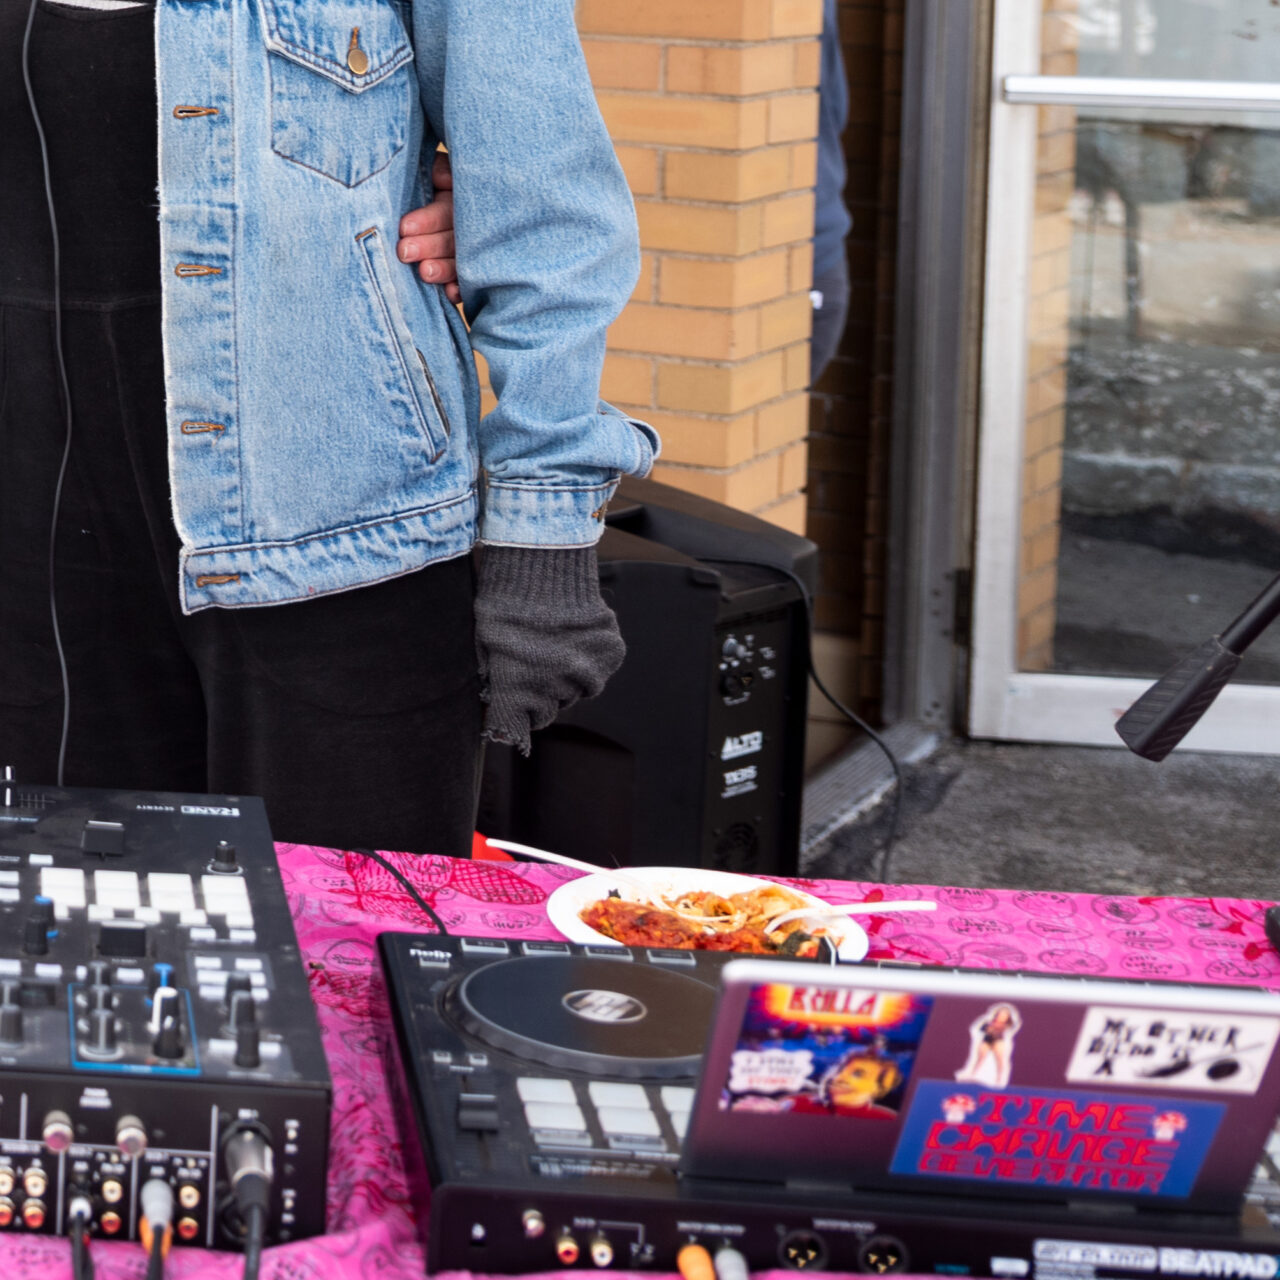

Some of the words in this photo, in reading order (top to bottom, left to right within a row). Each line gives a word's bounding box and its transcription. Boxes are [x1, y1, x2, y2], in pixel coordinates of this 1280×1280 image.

[979, 1092, 1156, 1136] TIME
[926, 1120, 1180, 1170] CHANGE
[918, 1151, 1165, 1195] GENERATOR
[1158, 1246, 1277, 1279] BEATPAD
